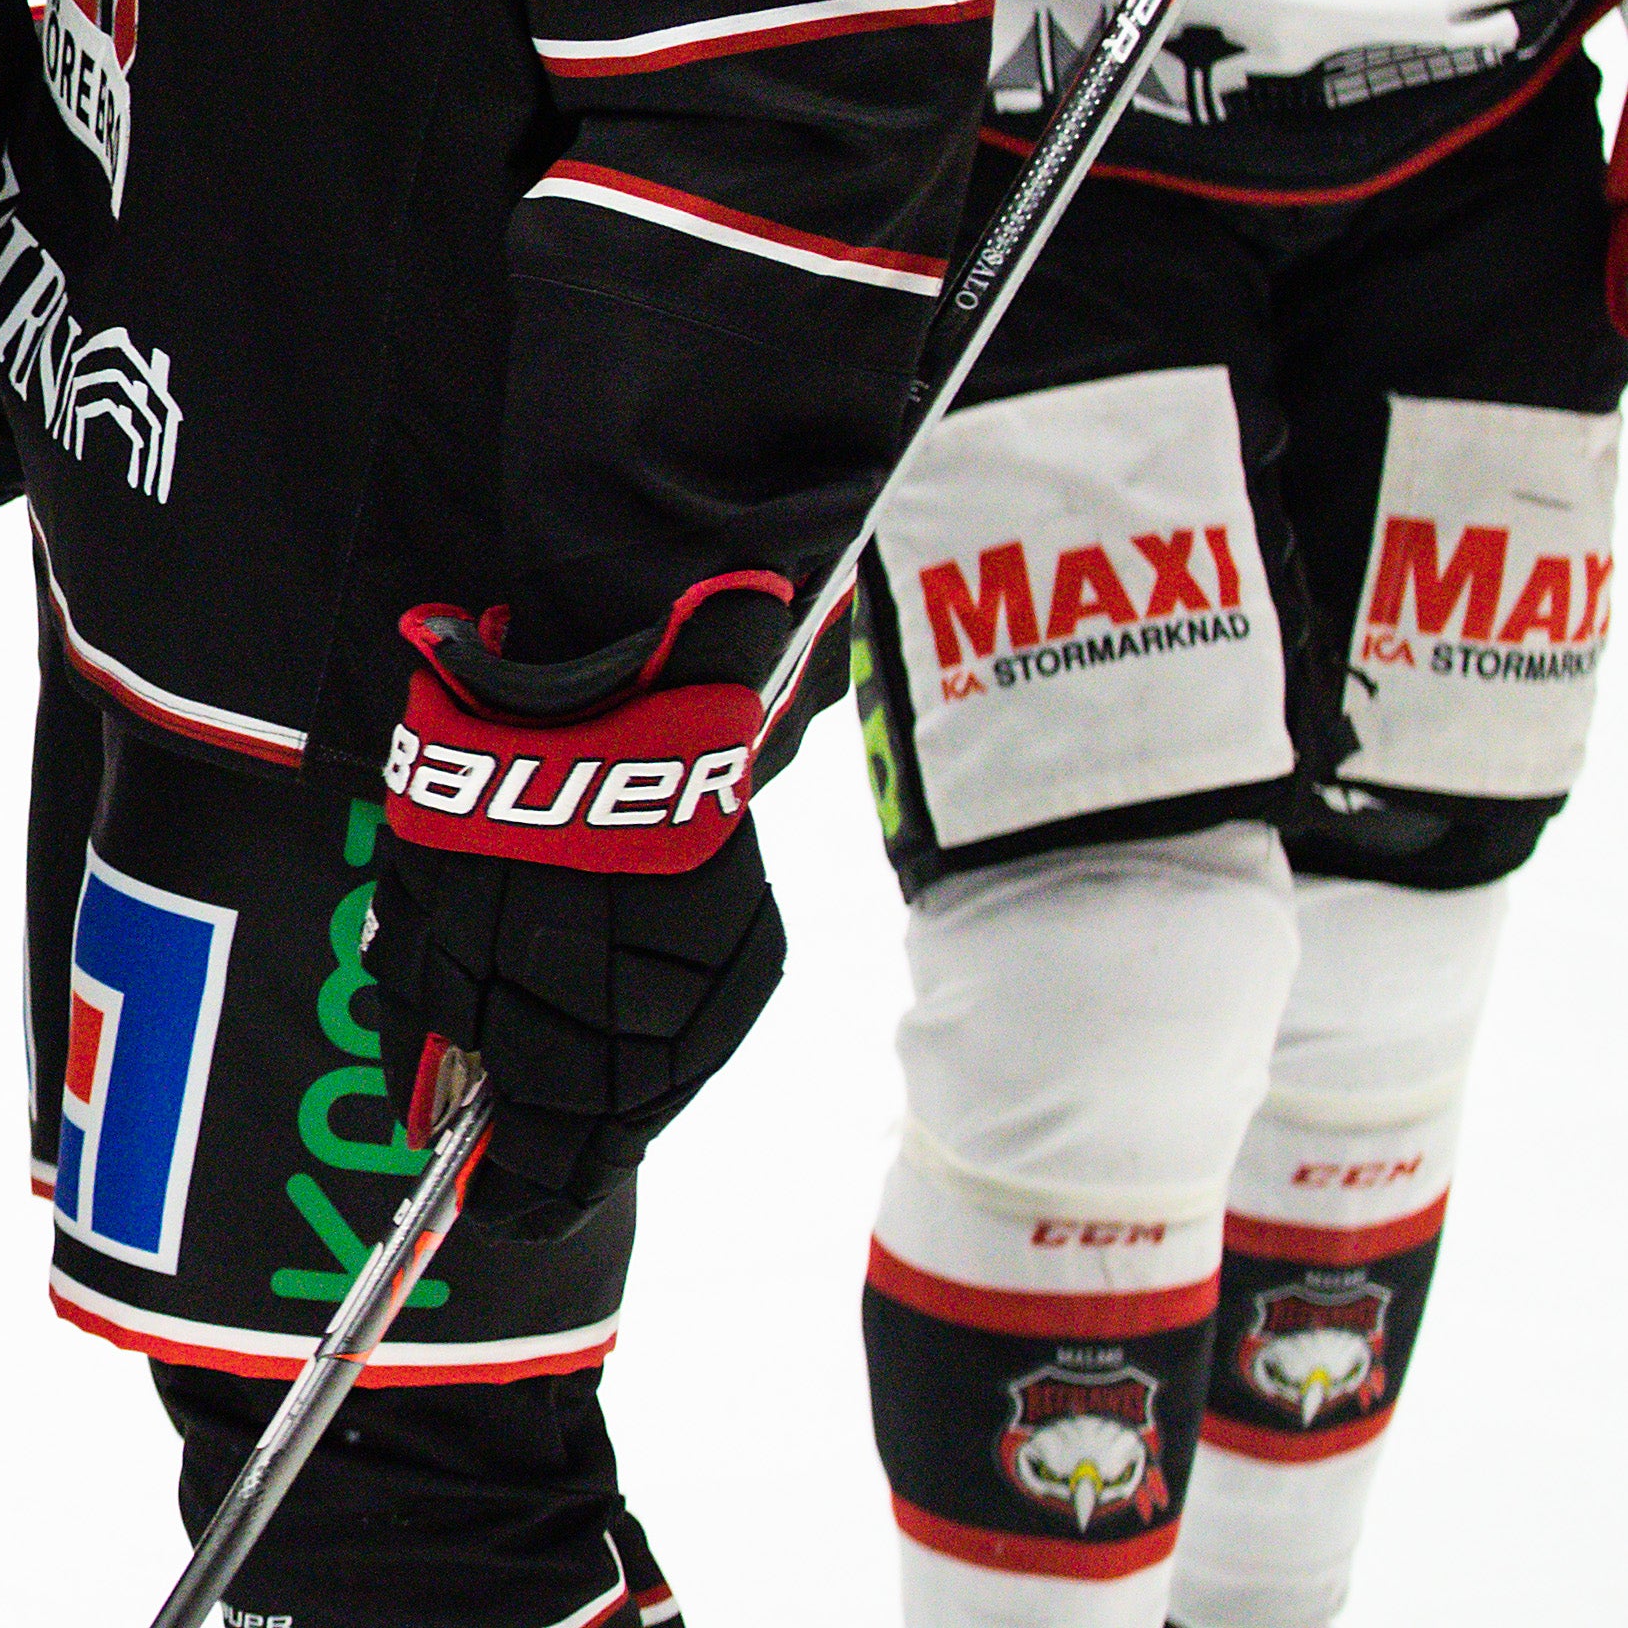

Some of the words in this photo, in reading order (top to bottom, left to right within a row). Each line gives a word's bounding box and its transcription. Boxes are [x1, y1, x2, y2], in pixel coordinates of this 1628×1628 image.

[919, 525, 1243, 669] MAXI
[992, 612, 1251, 689] STORMARKNAD
[382, 723, 749, 829] BAUER
